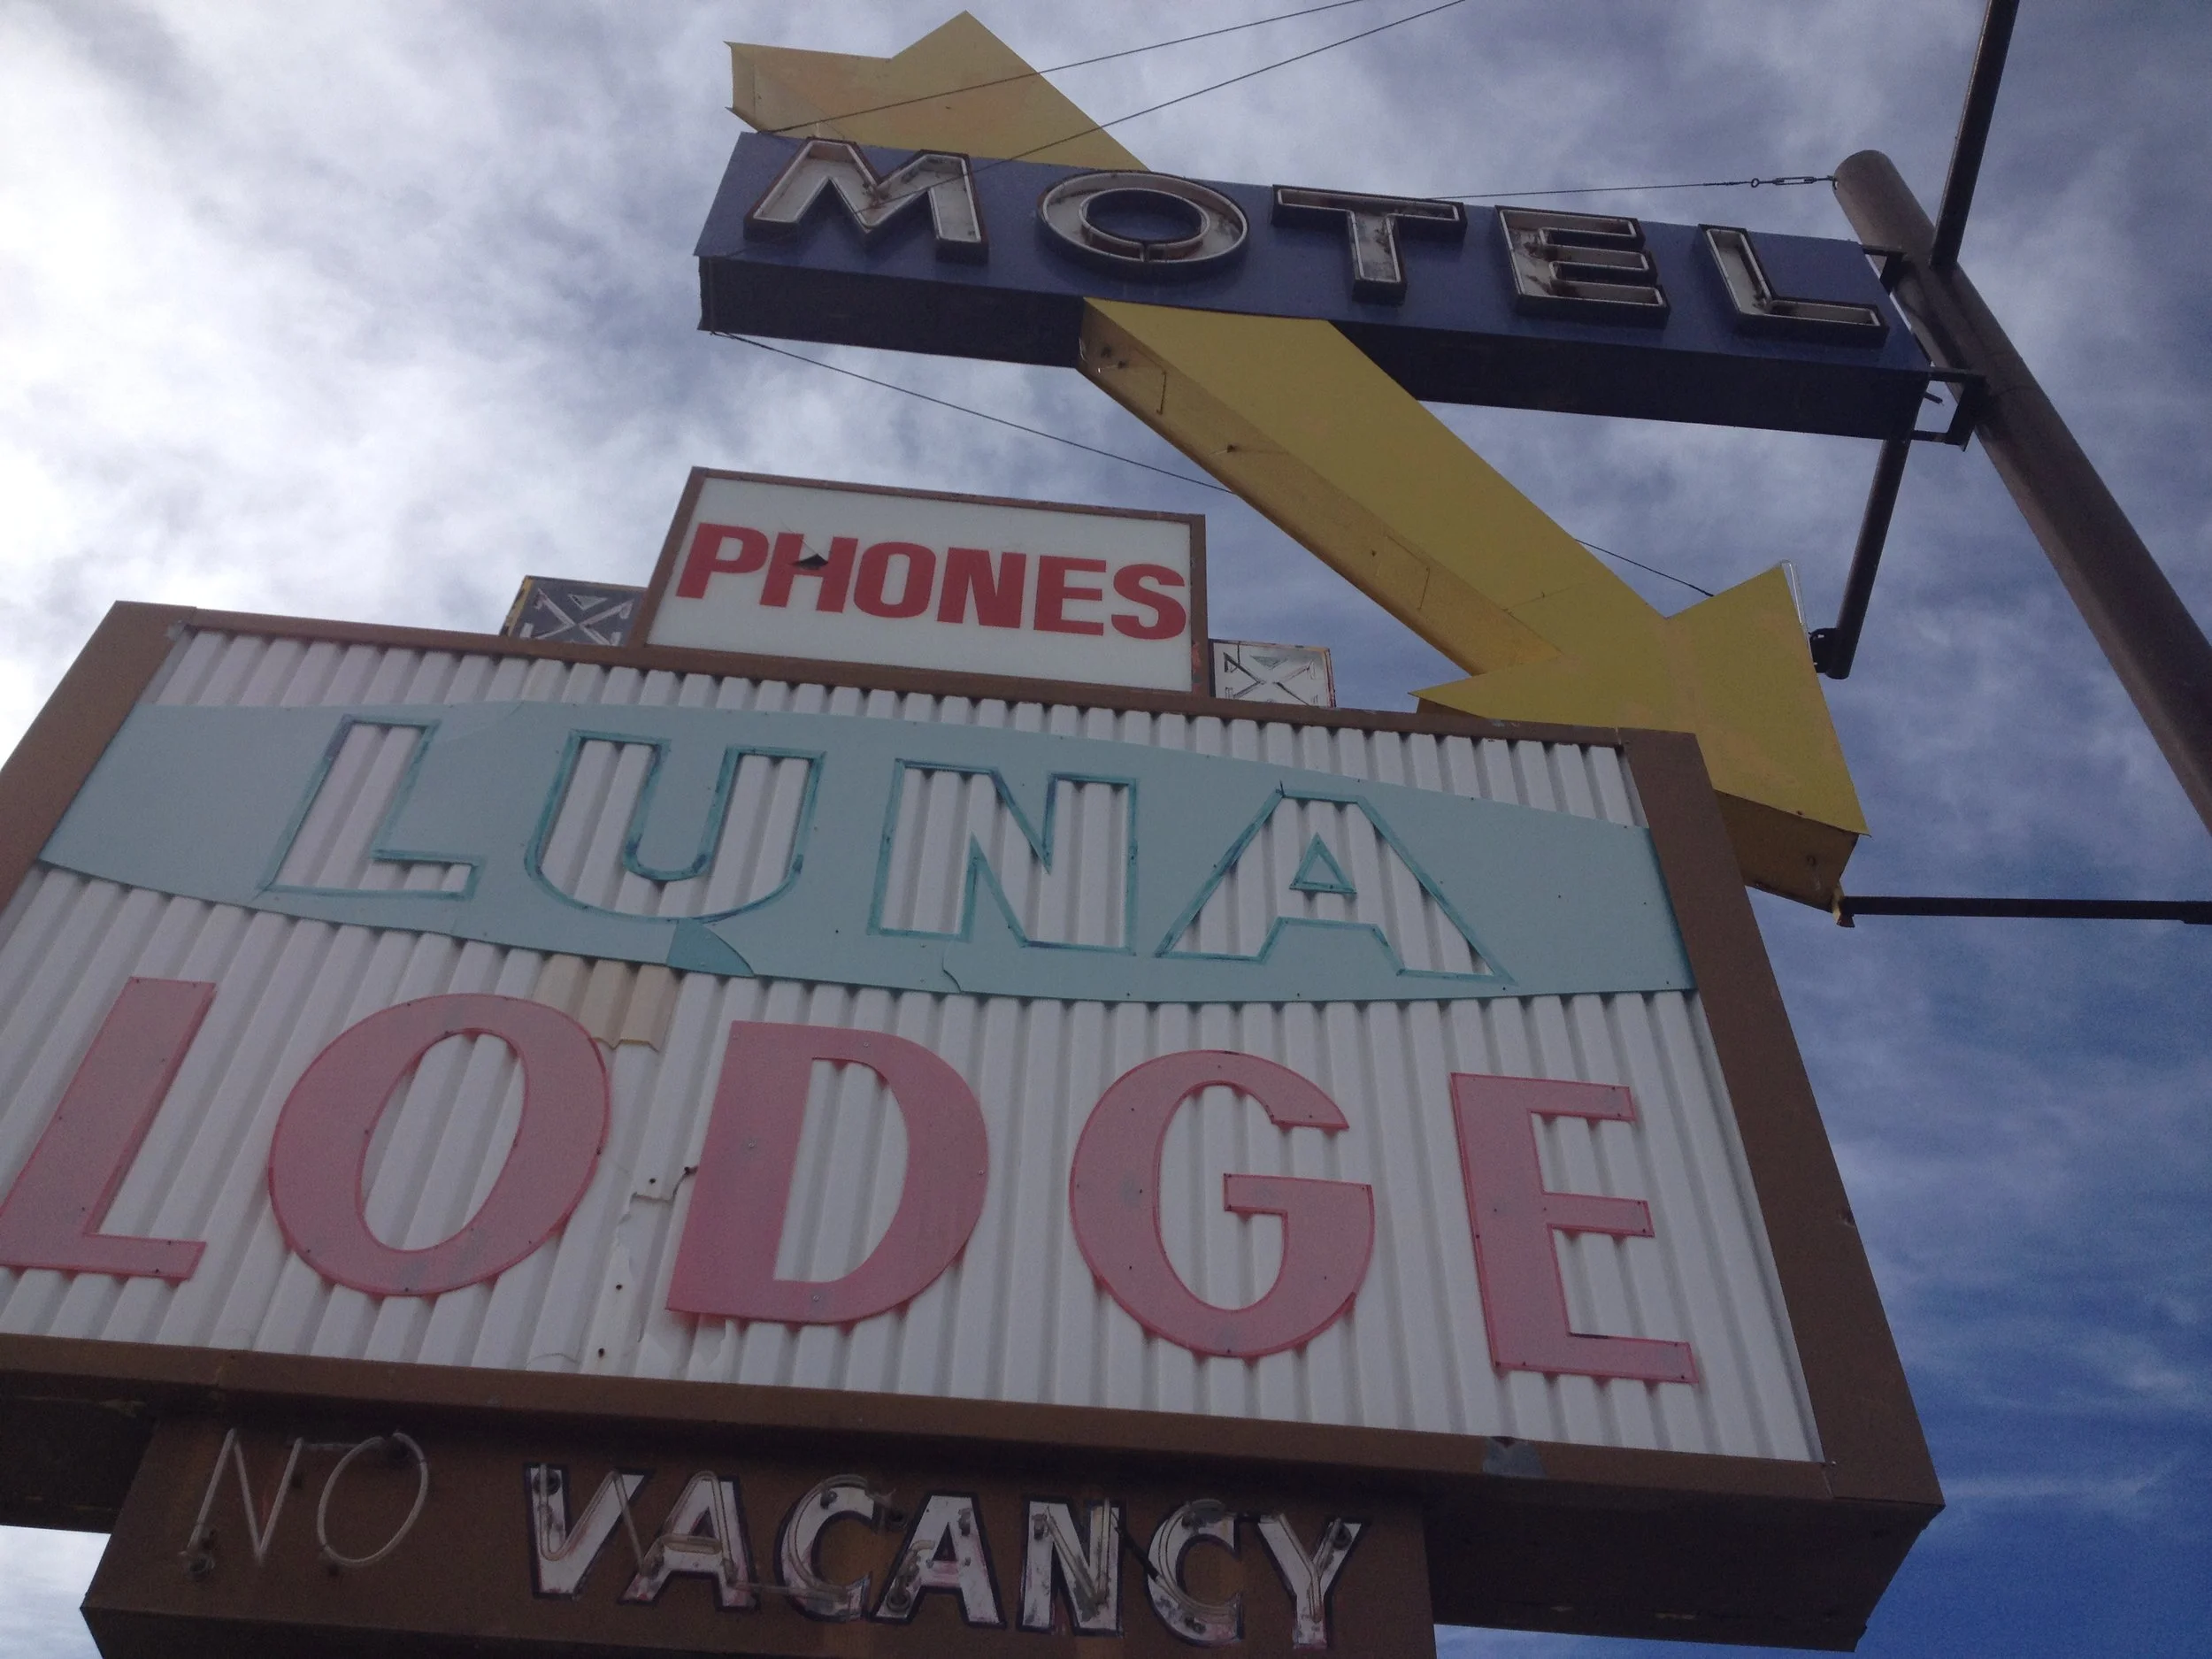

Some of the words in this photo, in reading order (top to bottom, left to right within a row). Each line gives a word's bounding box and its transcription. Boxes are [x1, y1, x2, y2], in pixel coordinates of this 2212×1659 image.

[745, 136, 1890, 347] MOTEL
[676, 522, 1187, 641] PHONES
[257, 715, 1515, 985] LUNA
[0, 976, 1699, 1384] LODGE
[184, 1429, 430, 1568] NO
[524, 1463, 1368, 1651] VACANCY
